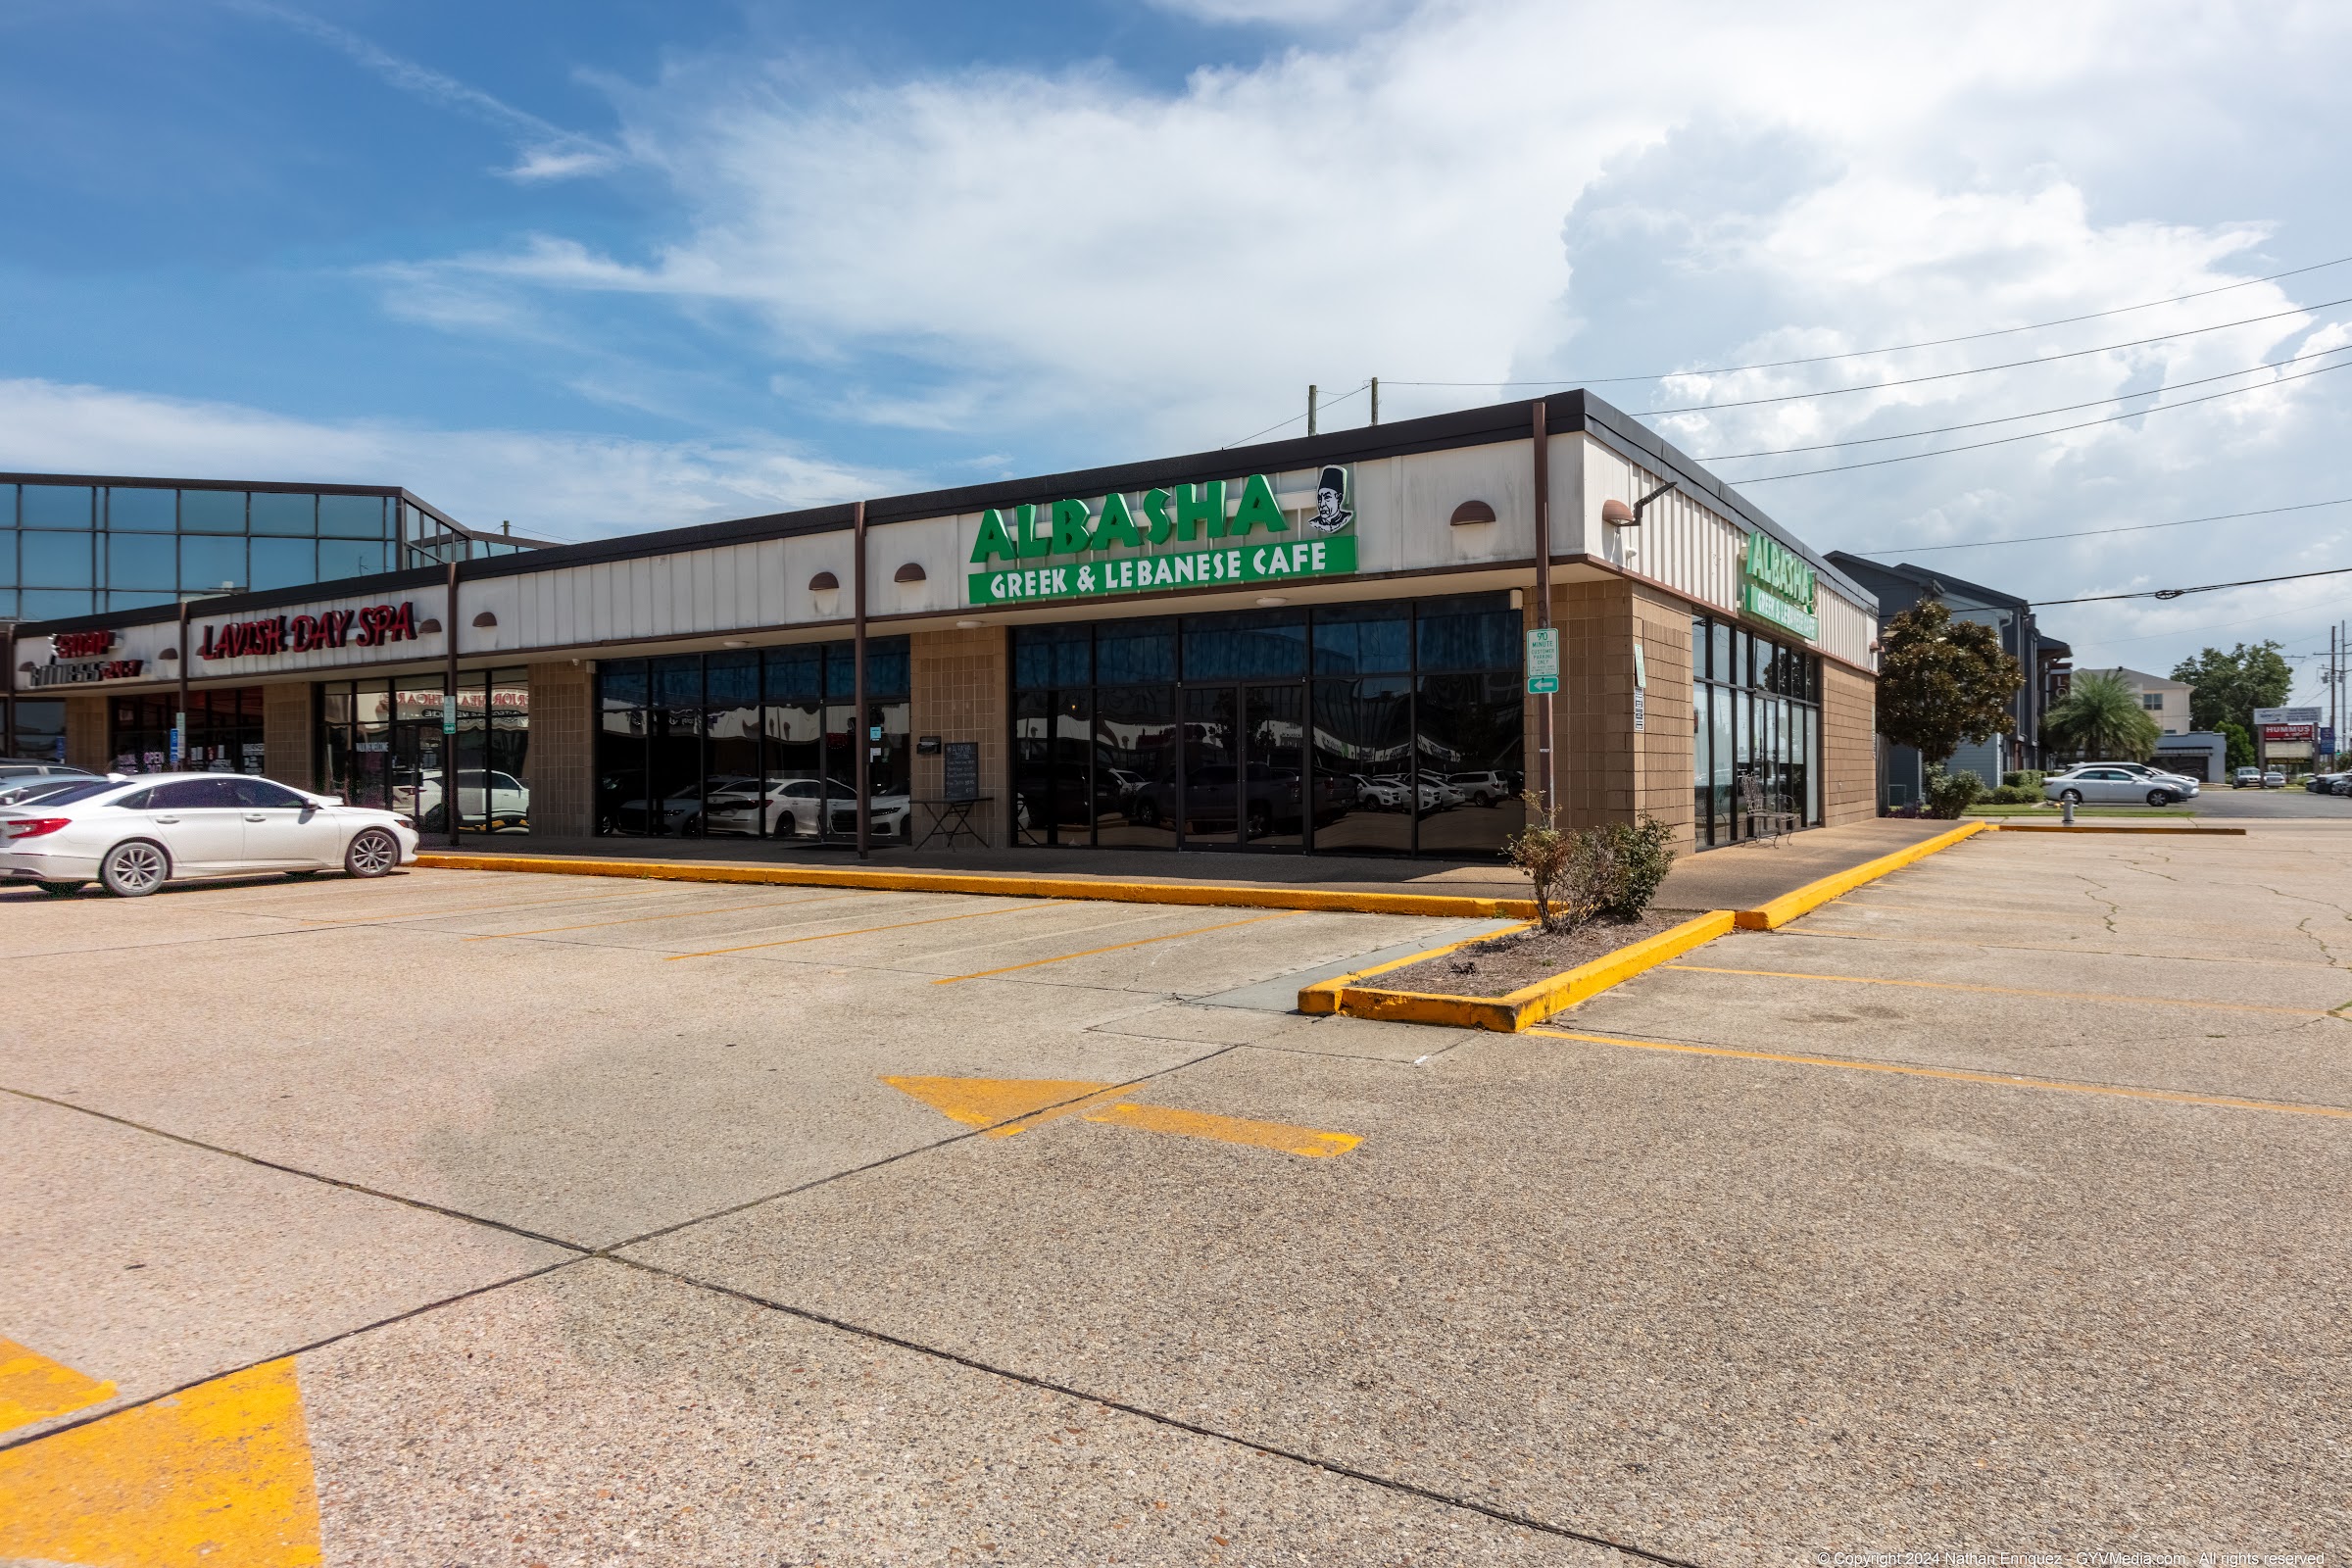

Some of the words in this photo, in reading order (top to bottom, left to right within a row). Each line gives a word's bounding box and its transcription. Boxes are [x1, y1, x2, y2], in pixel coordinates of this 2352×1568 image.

[970, 474, 1290, 564] ALBASHA
[990, 568, 1066, 599] GREEK
[1077, 565, 1096, 593] &
[1104, 550, 1242, 590] LEBANESE
[1252, 541, 1327, 576] CAFE
[1747, 531, 1812, 606] ALBASHA
[203, 615, 288, 661] LAVISH
[291, 609, 355, 653] DAY
[356, 602, 417, 647] SPA
[1537, 632, 1548, 641] 90
